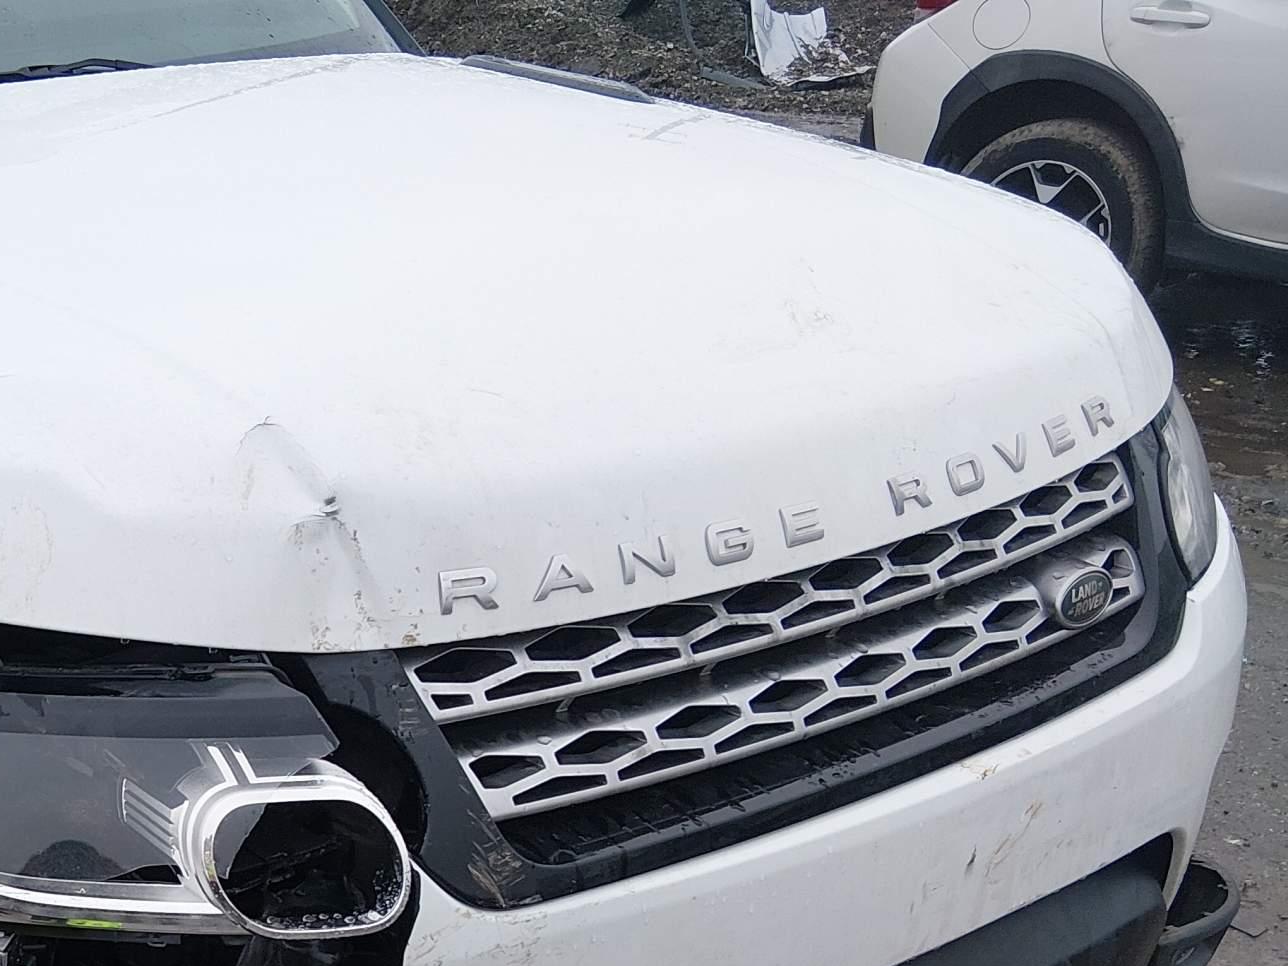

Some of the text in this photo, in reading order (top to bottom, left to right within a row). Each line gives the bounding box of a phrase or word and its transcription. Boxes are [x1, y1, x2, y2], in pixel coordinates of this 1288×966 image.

[438, 395, 1115, 615] RANGE ROVER
[1071, 580, 1098, 604] LAND
[1073, 591, 1106, 617] ROVER
